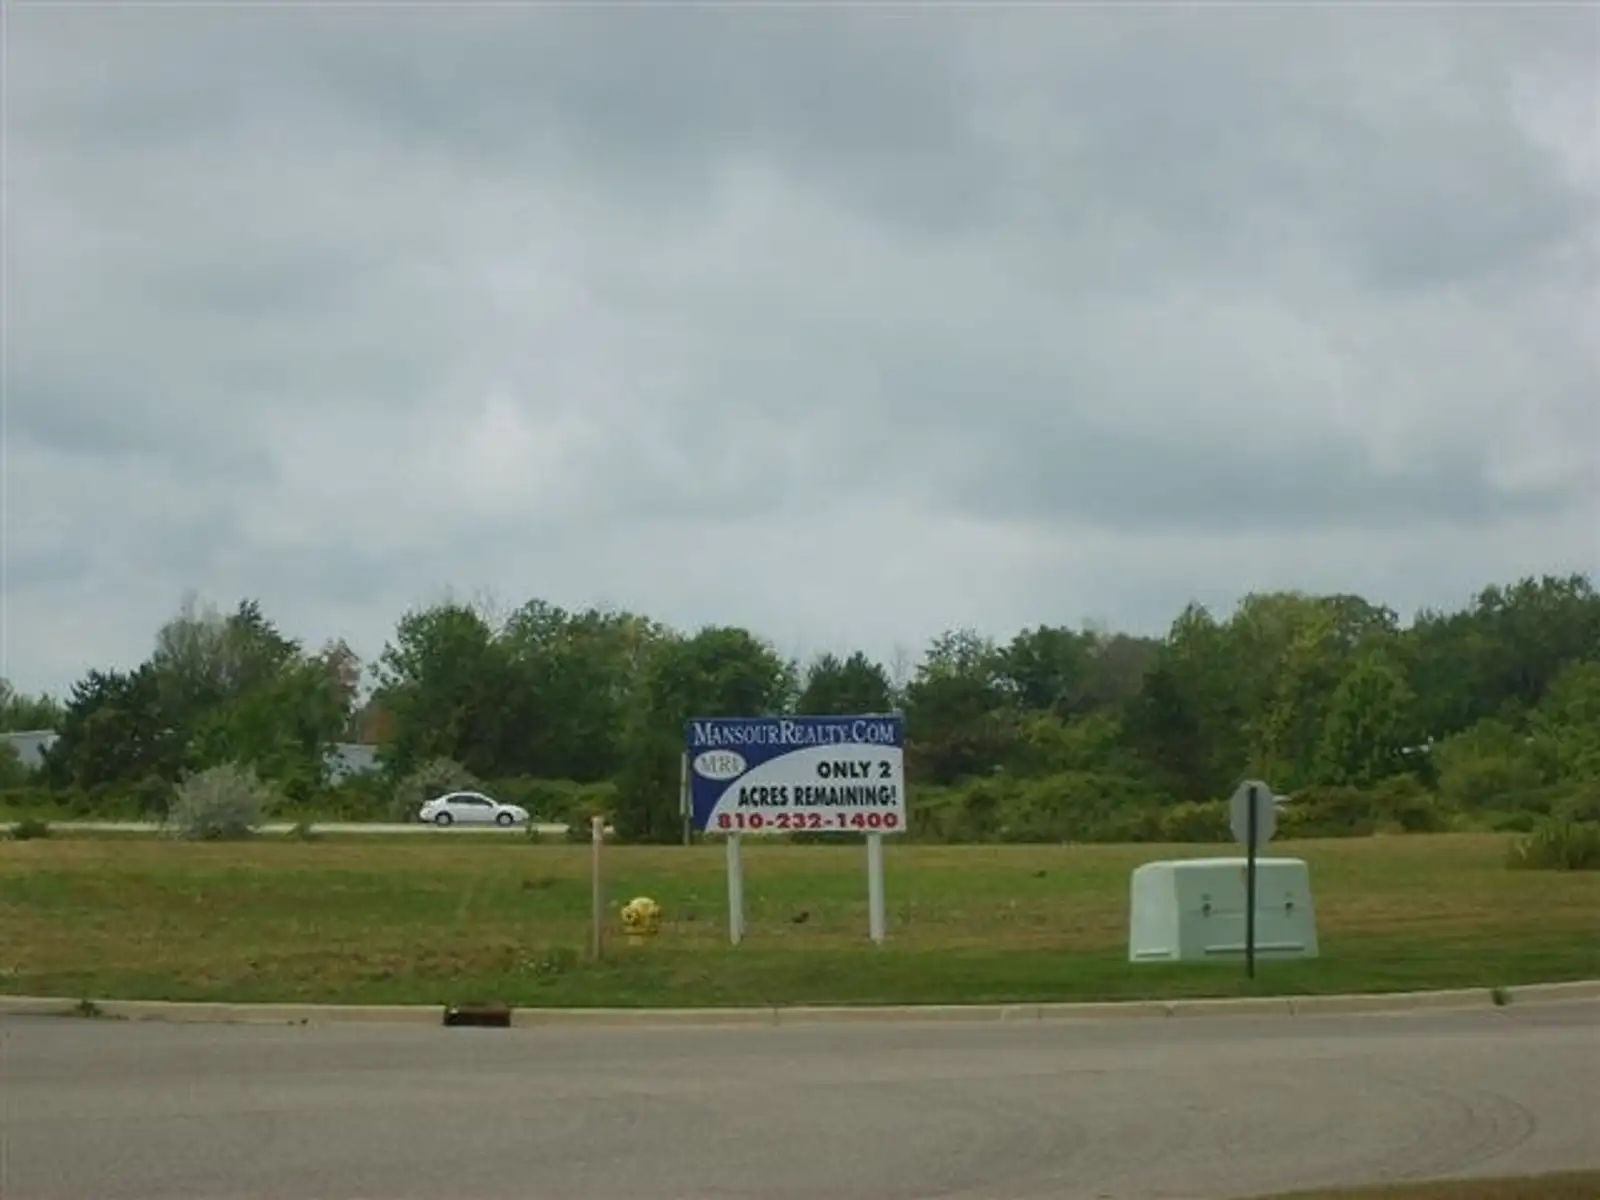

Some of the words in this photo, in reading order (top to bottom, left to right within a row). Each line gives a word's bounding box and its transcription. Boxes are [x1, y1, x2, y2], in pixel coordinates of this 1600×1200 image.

[817, 761, 871, 779] ONLY
[880, 761, 892, 778] 2
[738, 786, 789, 807] ACRES
[794, 785, 897, 806] REMAINING!
[718, 812, 899, 829] 810-232-1400
